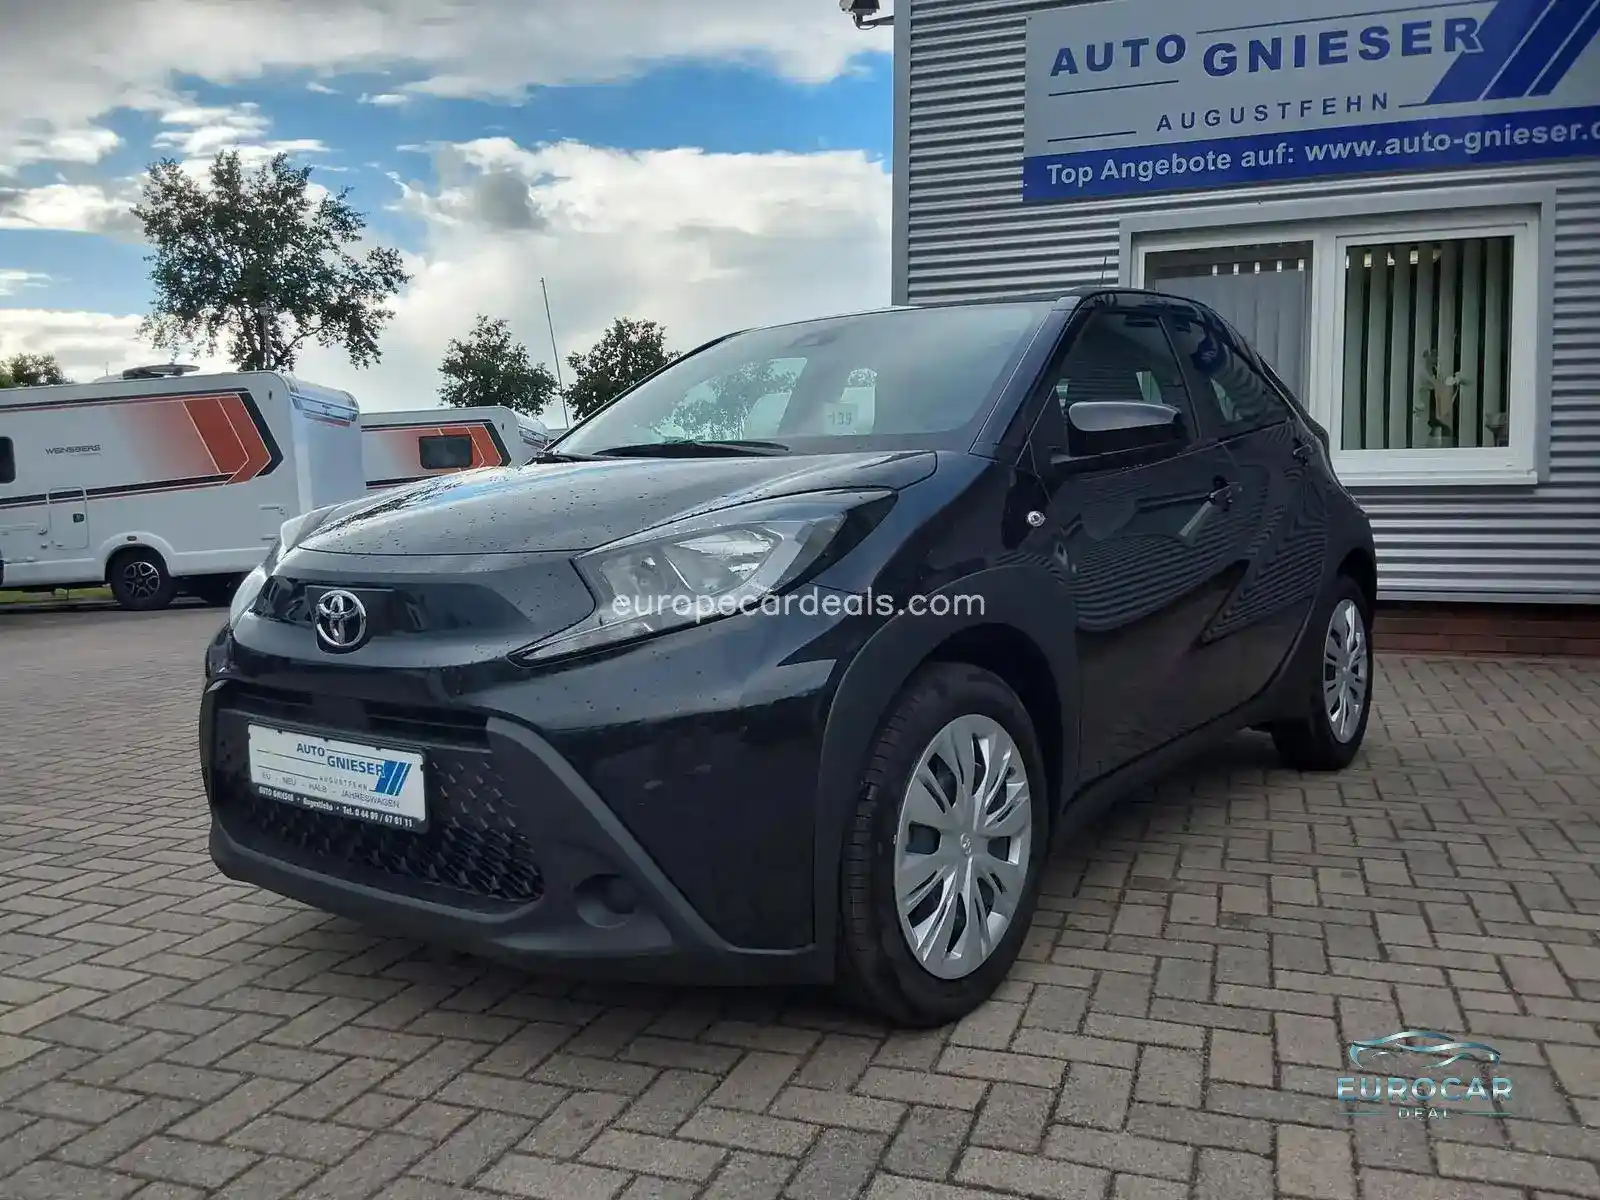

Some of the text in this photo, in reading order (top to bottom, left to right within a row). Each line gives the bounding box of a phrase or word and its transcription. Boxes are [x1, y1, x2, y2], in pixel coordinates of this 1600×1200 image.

[1050, 17, 1484, 77] AUTO GNIESER
[1157, 92, 1389, 132] AUGUSTFEHN
[1047, 162, 1094, 187] Top
[1101, 151, 1232, 186] Angebote
[1241, 142, 1295, 168] auf:
[297, 742, 386, 779] AUTO GNIESER
[341, 789, 401, 809] JAHRESWAGEN
